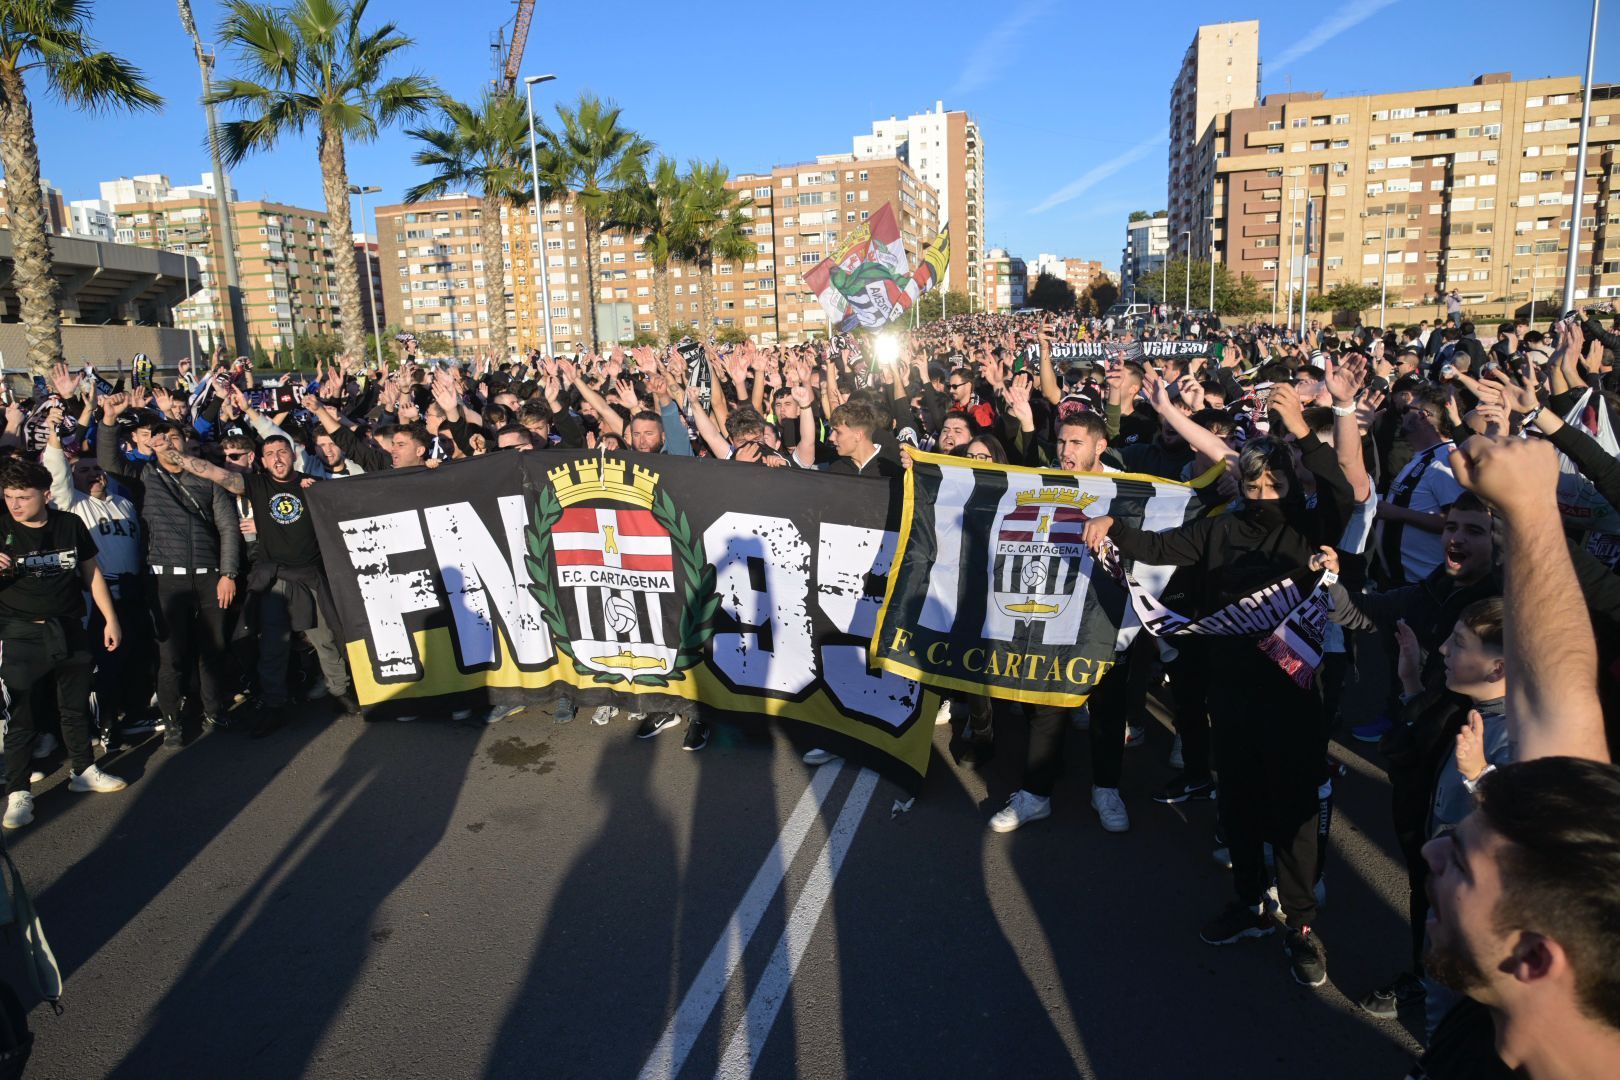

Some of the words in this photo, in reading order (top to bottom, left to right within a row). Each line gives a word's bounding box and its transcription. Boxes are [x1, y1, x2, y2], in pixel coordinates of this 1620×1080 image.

[99, 517, 137, 539] GAP
[1000, 544, 1016, 553] F.C.
[1018, 544, 1080, 555] CARTAGENA
[562, 571, 586, 583] F.C.
[590, 571, 671, 589] CARTAGENA
[338, 495, 554, 677] FN
[703, 511, 921, 728] 95
